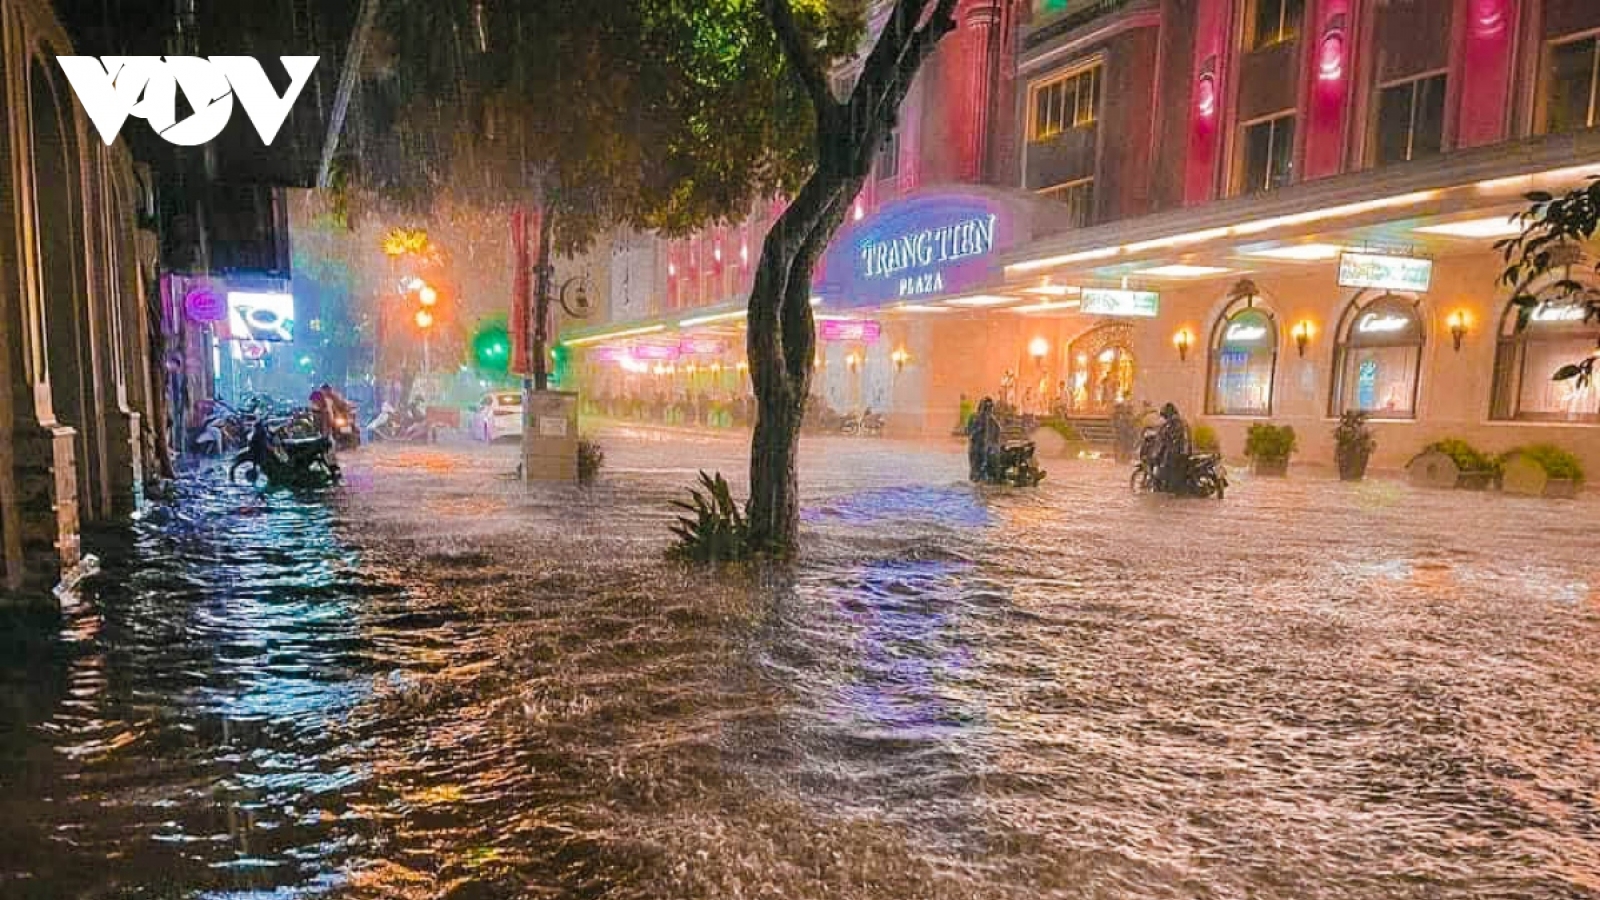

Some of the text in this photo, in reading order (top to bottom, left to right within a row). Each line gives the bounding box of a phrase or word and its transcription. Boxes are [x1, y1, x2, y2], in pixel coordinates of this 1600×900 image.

[862, 213, 996, 278] TRANG TIEN
[899, 272, 944, 296] PLAZA
